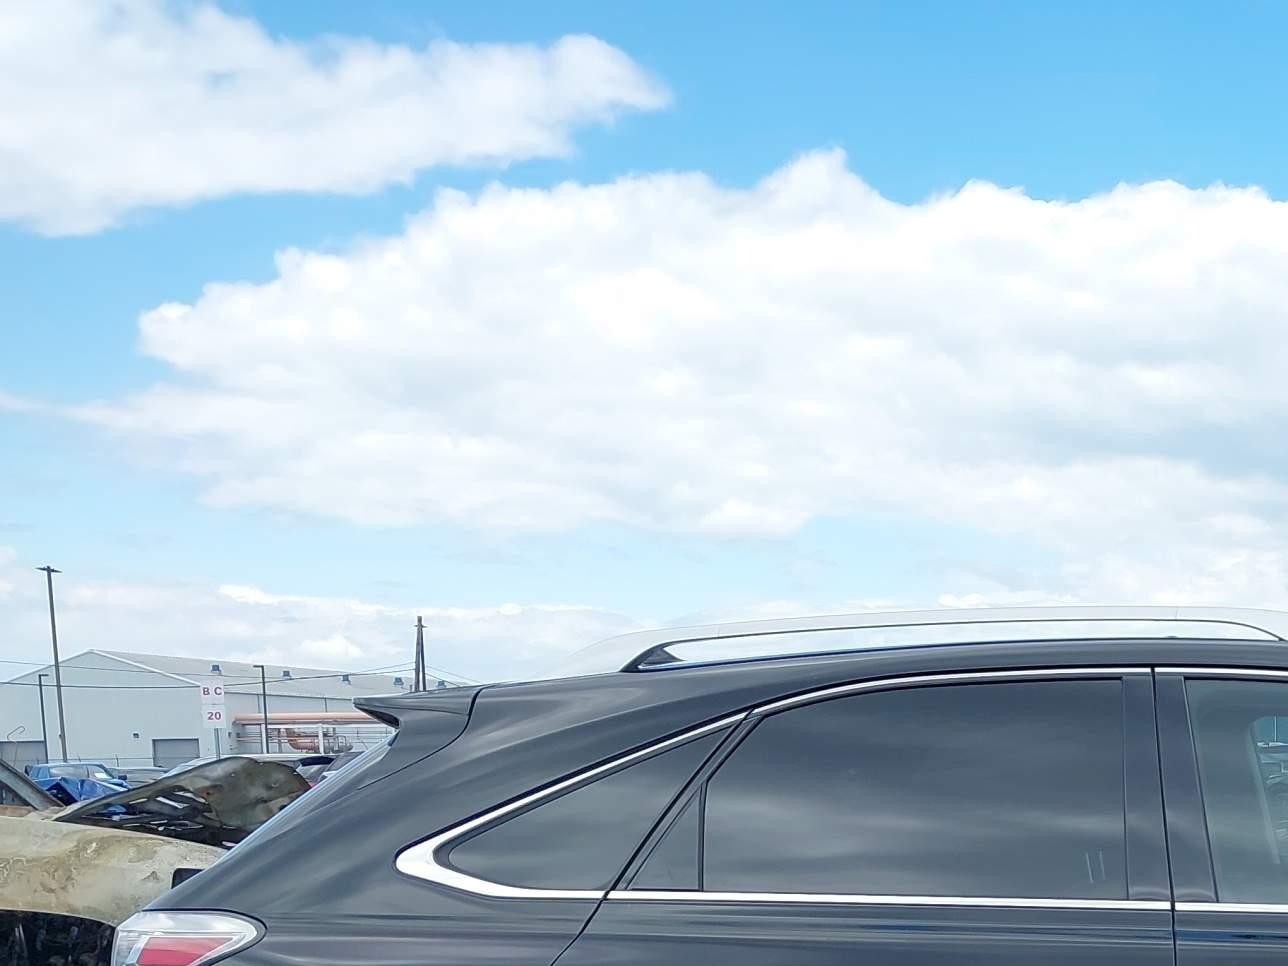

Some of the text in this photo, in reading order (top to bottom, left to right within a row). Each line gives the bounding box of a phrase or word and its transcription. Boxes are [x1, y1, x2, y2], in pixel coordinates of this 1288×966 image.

[202, 687, 222, 696] B C
[207, 711, 222, 720] 20
